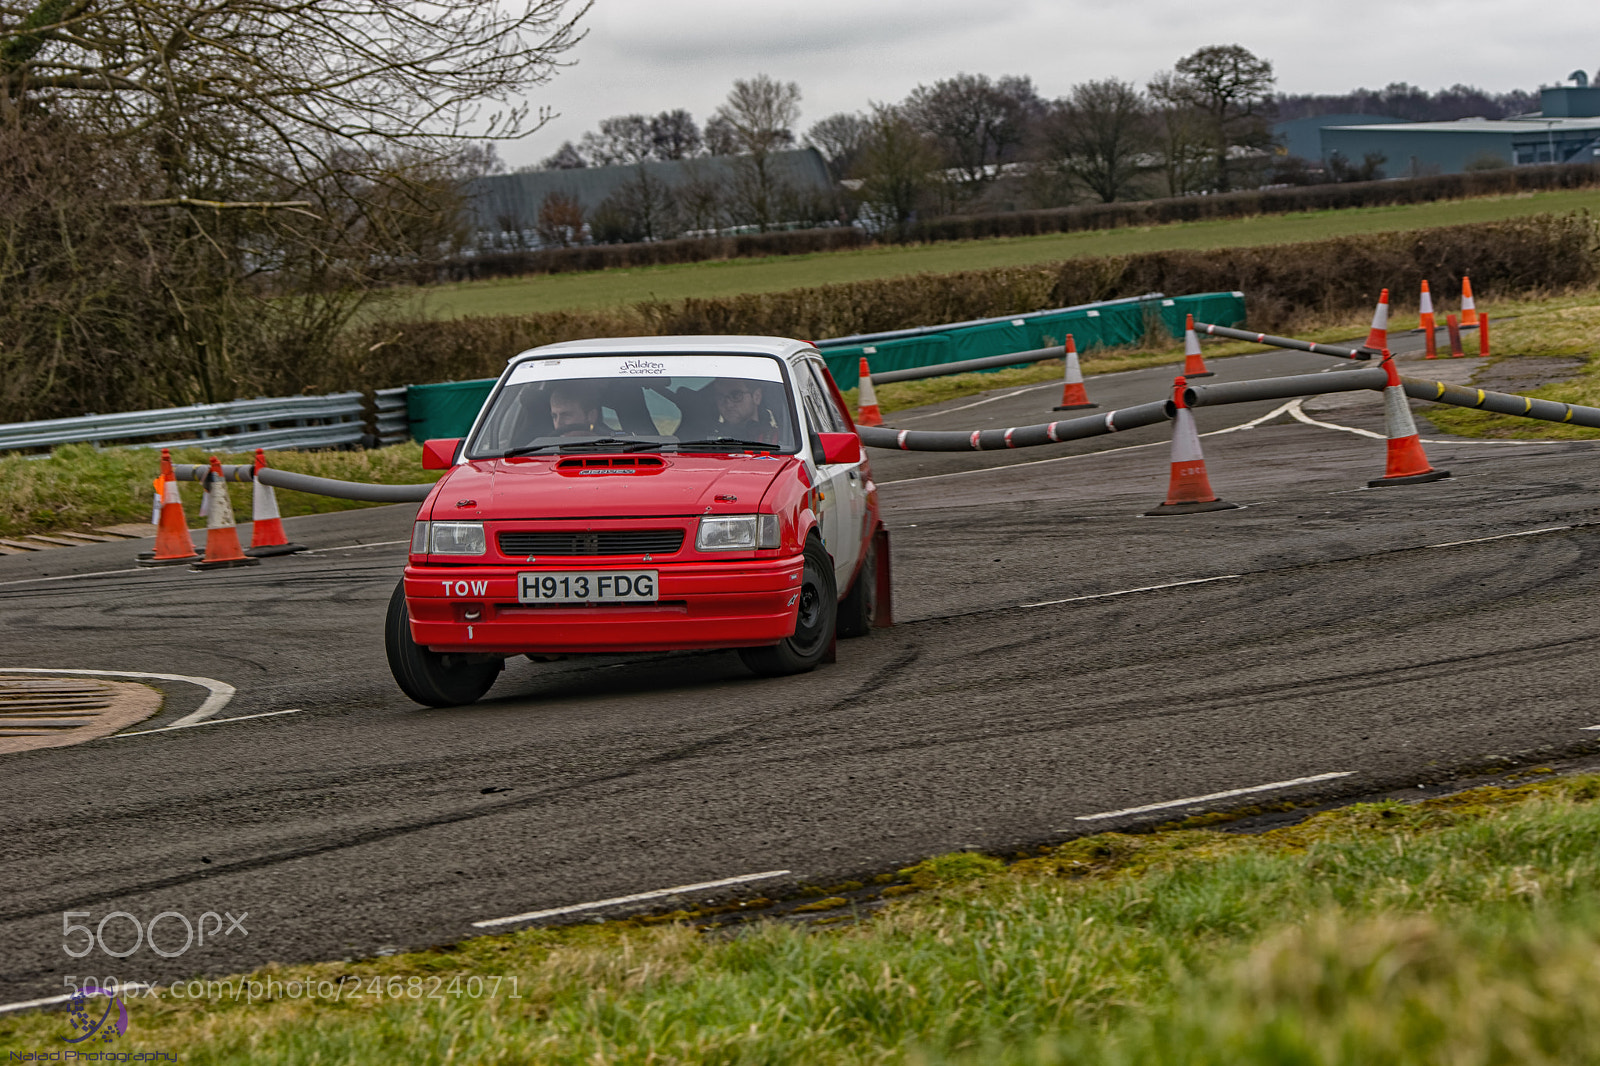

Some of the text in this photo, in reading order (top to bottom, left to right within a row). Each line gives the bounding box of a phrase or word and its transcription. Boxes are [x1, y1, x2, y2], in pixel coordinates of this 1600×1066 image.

[442, 580, 488, 596] TOW
[522, 575, 654, 598] H913 FDG
